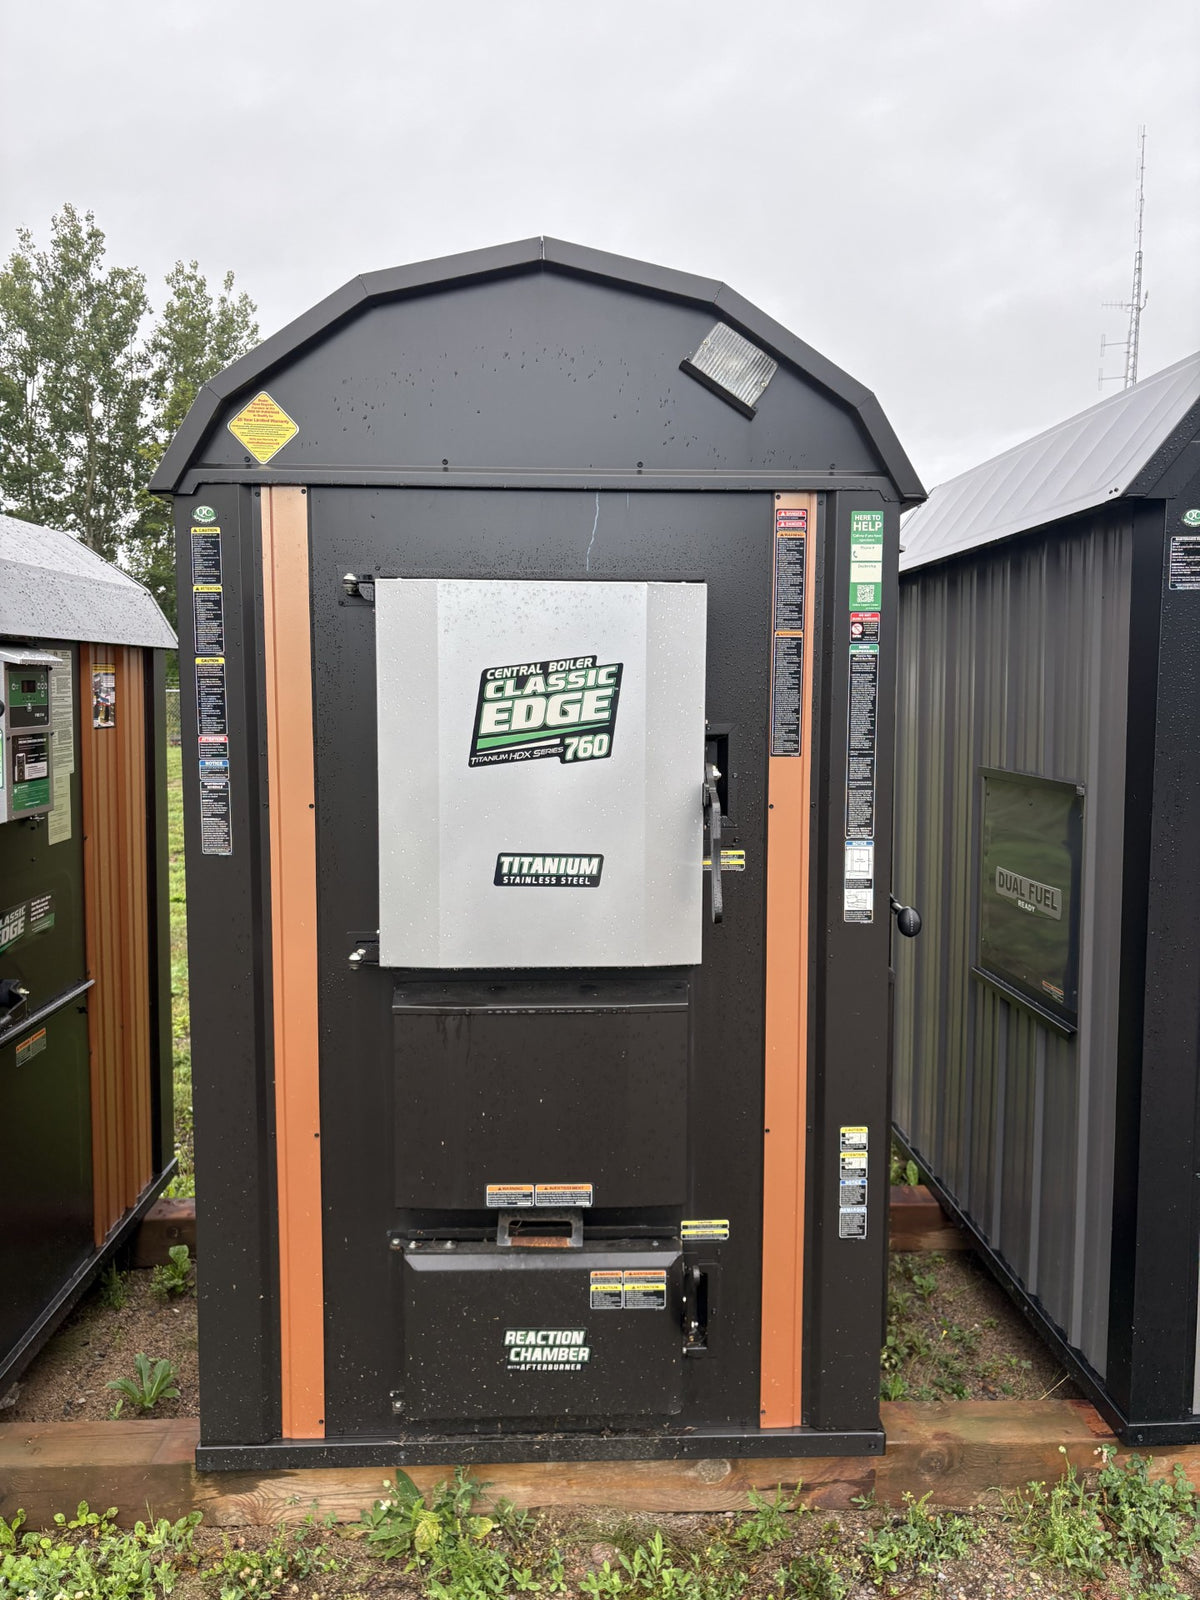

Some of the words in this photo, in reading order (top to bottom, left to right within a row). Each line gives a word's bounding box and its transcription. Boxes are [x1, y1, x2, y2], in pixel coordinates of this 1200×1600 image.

[853, 521, 882, 531] HELP
[487, 664, 543, 679] CENTRAL
[548, 657, 593, 673] BOILER
[484, 665, 618, 700] CLASSIC
[479, 687, 615, 736] EDGE
[471, 754, 508, 764] TITANIUM
[509, 750, 531, 760] HDX
[533, 746, 564, 758] SERIES
[564, 733, 611, 761] 760
[500, 856, 600, 875] TITANIUM
[560, 877, 590, 885] STEEL
[998, 872, 1025, 898] DUAL
[1029, 883, 1057, 911] FUEL
[1018, 900, 1035, 912] READY
[0, 905, 26, 928] LASSIC
[0, 916, 25, 947] DGE
[504, 1330, 586, 1346] REACTION
[509, 1347, 590, 1362] CHAMBER
